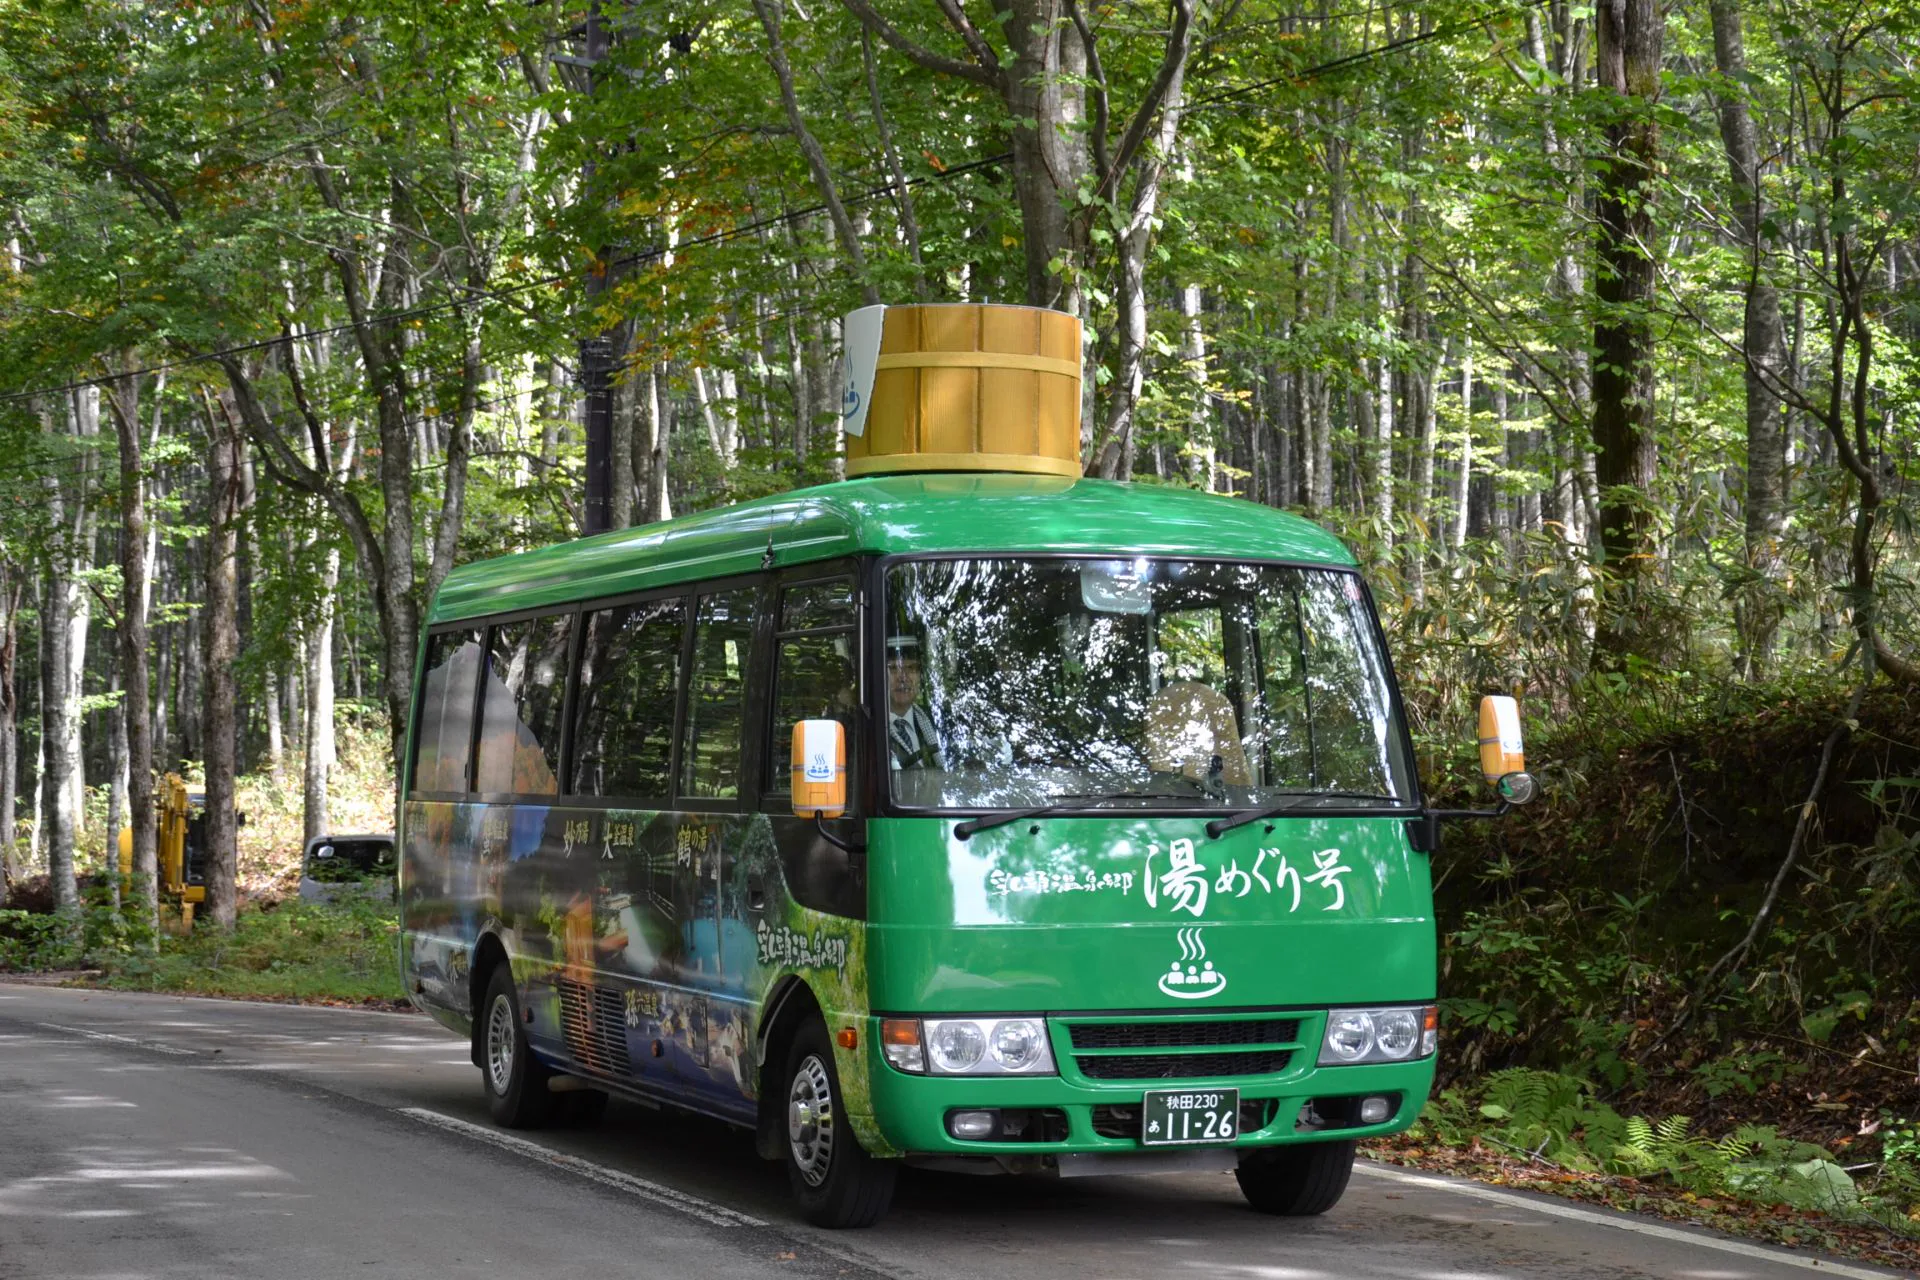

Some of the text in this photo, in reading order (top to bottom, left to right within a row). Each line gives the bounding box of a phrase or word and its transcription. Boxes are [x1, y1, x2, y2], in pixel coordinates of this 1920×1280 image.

[677, 823, 708, 869] 鶴の湯
[989, 837, 1352, 917] 乳頭温泉郷 湯めぐり号
[757, 918, 846, 982] 乳頭温泉郷
[1148, 1110, 1233, 1140] あ 11-26
